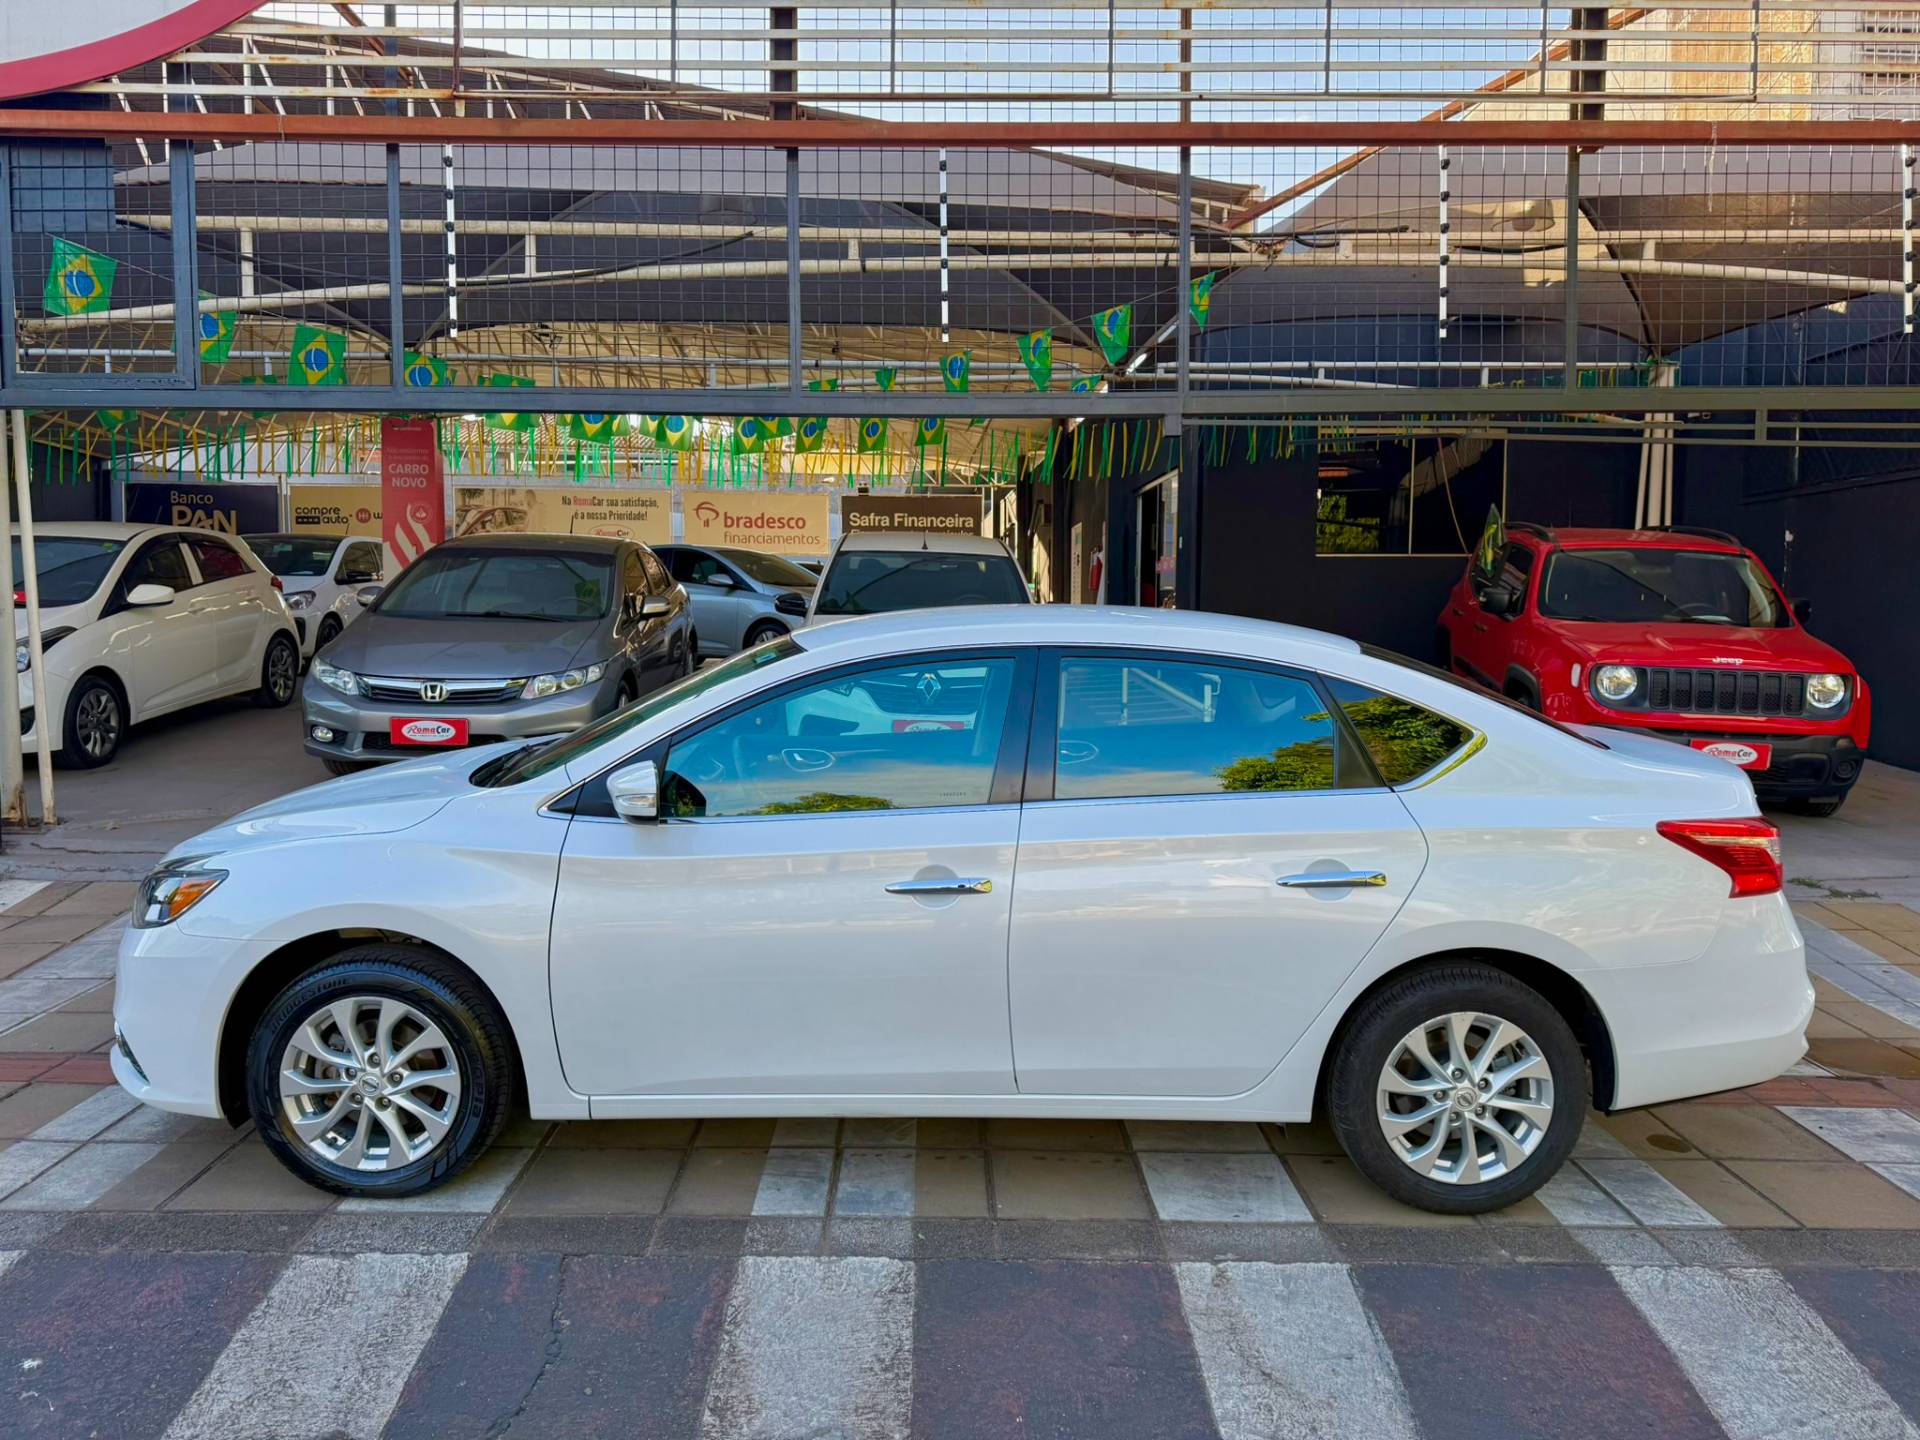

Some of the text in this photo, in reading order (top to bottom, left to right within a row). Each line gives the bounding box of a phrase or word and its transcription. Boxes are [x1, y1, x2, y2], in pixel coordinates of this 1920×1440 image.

[388, 463, 429, 475] CARRO
[391, 477, 427, 488] NOVO
[170, 490, 214, 504] Banco
[561, 496, 572, 506] Na
[606, 498, 619, 507] sua
[295, 506, 341, 517] compre
[580, 512, 585, 520] a
[586, 512, 608, 520] nossa
[608, 510, 648, 521] Prioridade!
[171, 504, 237, 536] PAN
[321, 514, 350, 524] auto
[723, 511, 807, 529] bradesco
[849, 512, 974, 528] Safra Financeira
[723, 531, 821, 545] financiamentos
[1712, 656, 1744, 665] Jeep
[407, 725, 451, 735] RomaCar
[1708, 747, 1753, 758] RomaCar
